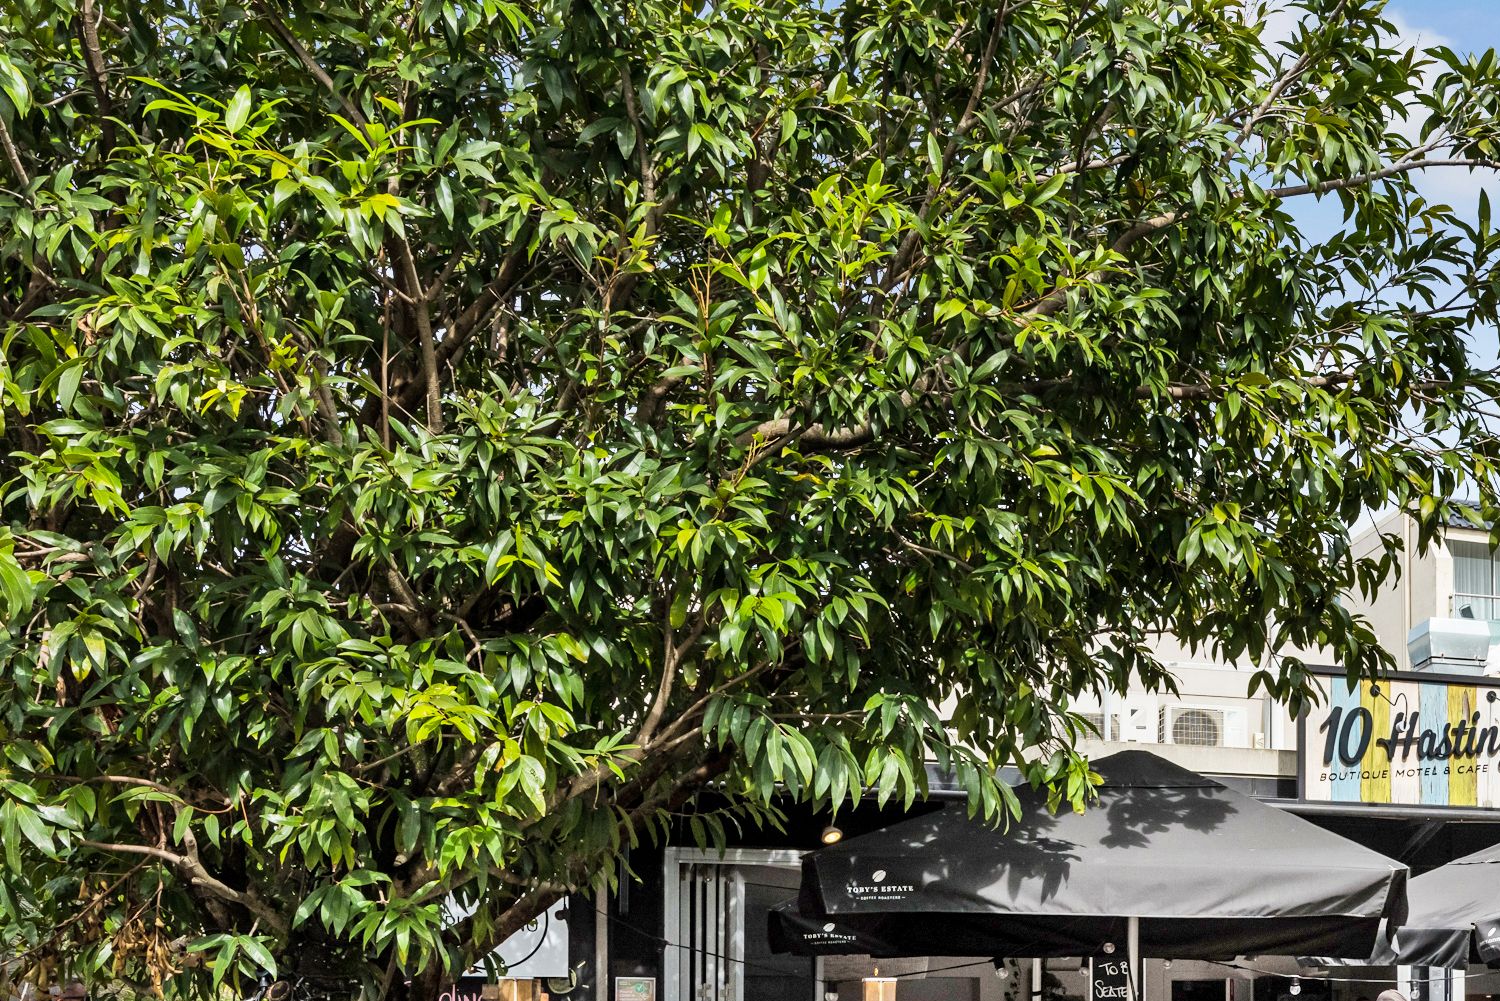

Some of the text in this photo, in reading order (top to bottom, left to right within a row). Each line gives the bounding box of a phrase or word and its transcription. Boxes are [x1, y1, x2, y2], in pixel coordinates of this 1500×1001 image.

[1320, 706, 1373, 768] 10
[1319, 764, 1489, 782] BOUTIQUE MOTEL & CAFE
[846, 885, 914, 894] TOBY'S ESTATE
[1098, 962, 1119, 976] TO
[1094, 980, 1128, 998] SEATE
